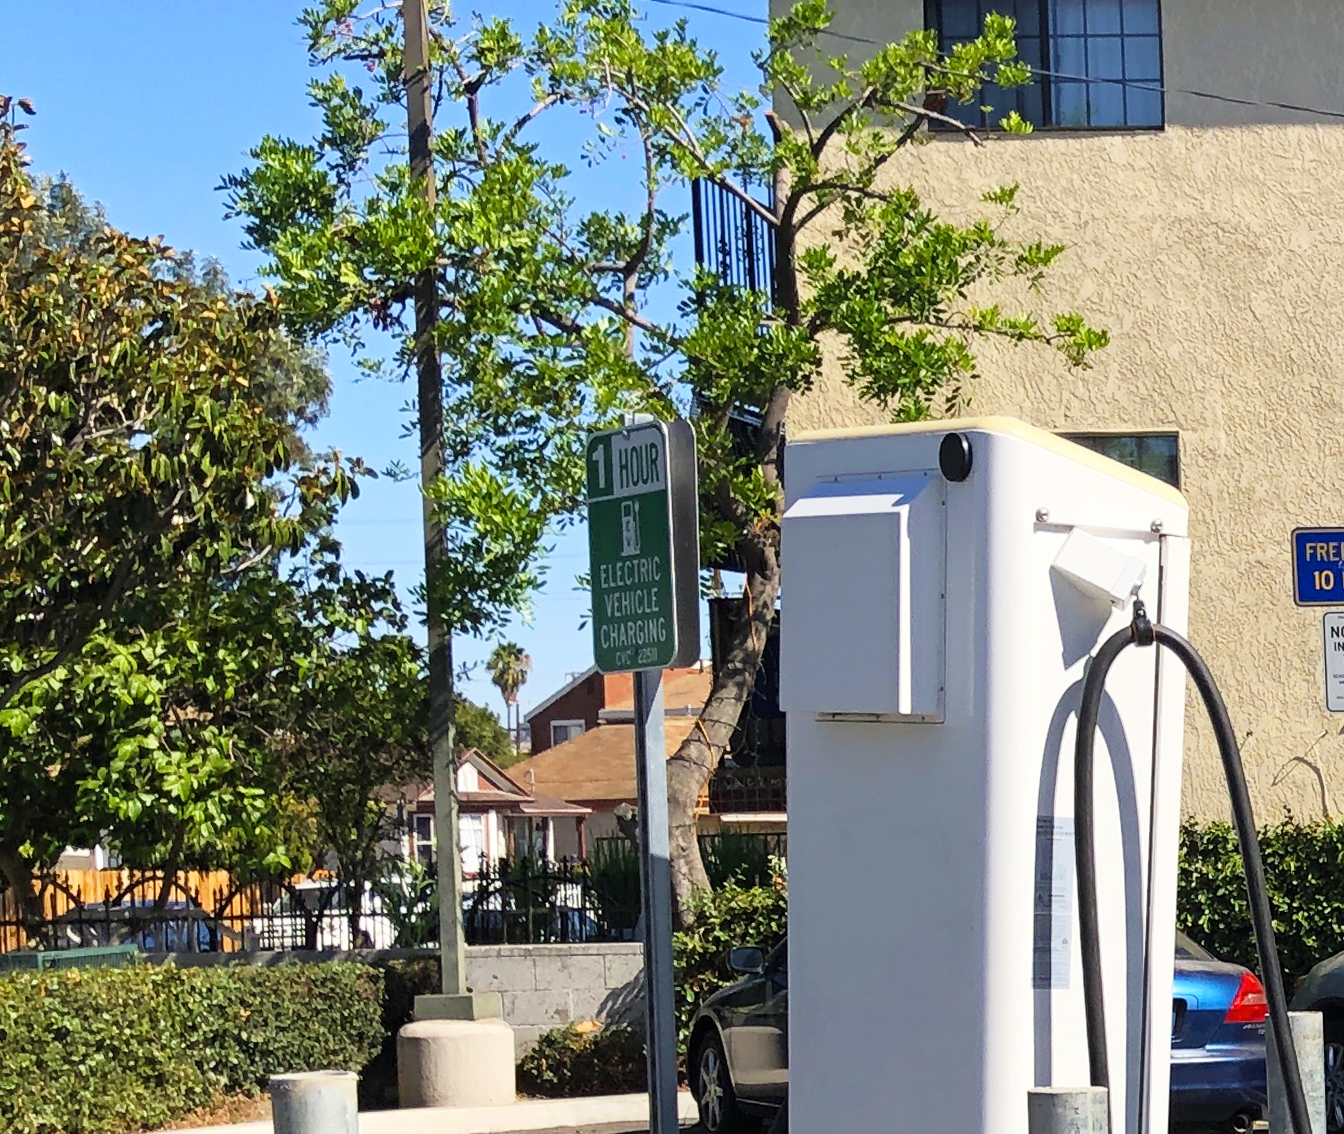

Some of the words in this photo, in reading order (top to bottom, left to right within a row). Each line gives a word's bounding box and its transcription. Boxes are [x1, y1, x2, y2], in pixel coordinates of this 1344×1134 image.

[591, 443, 606, 489] 1
[618, 441, 660, 489] HOUR
[599, 556, 662, 589] ELECTRIC
[1313, 570, 1335, 591] 10
[604, 587, 659, 618] VEHICLE
[600, 617, 667, 649] CHARGING
[1333, 641, 1344, 651] IN
